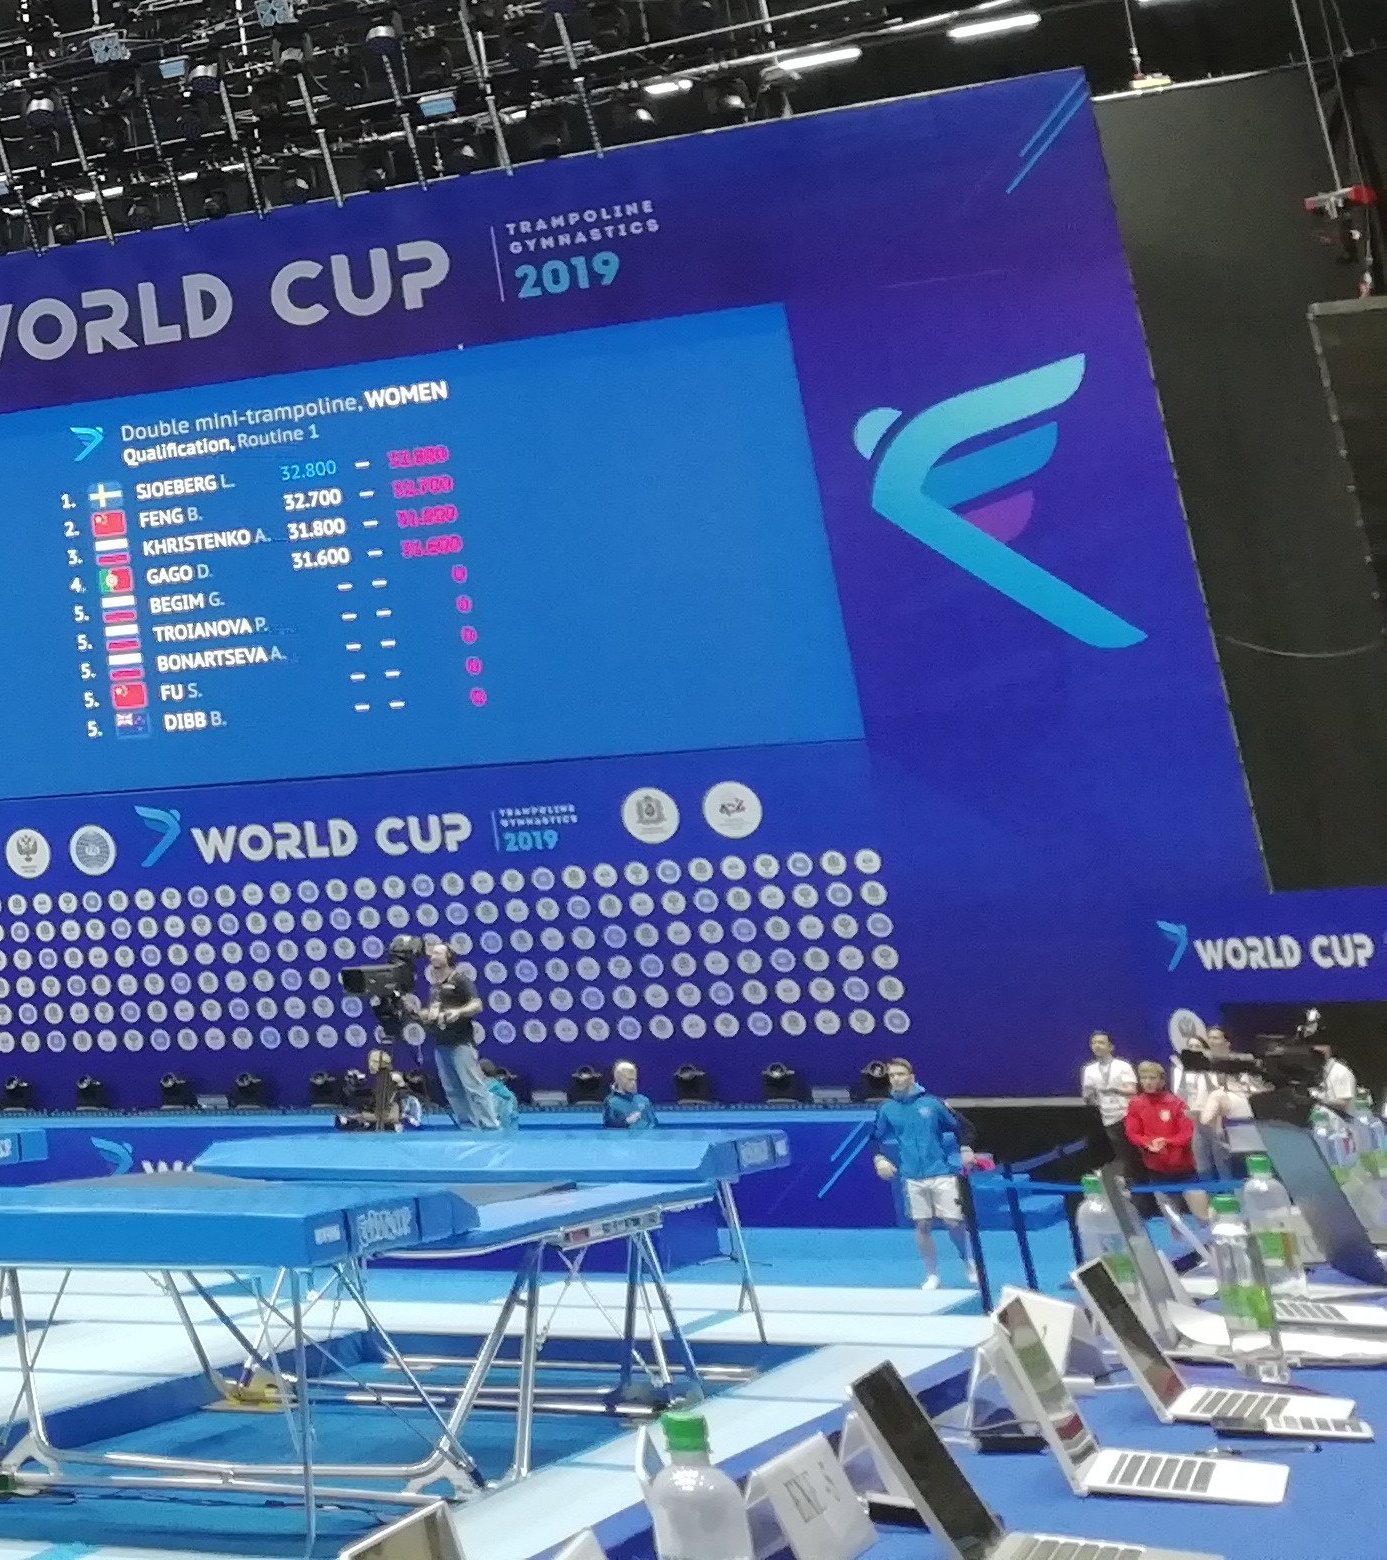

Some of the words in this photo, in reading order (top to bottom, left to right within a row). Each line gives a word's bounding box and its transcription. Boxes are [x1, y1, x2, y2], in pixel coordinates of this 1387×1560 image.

[505, 200, 654, 236] TRAMPOLINE
[509, 218, 660, 254] GYMNASTICS
[269, 240, 451, 326] CUP
[514, 251, 620, 298] 2019
[120, 418, 190, 442] Double
[195, 396, 363, 434] mini-trampoline,
[364, 380, 450, 409] WOMEN
[123, 436, 236, 467] Qualification,
[237, 429, 298, 450] Routine
[309, 424, 320, 440] 1
[61, 493, 77, 510] 1.
[135, 474, 217, 502] SJOEBERG
[280, 460, 336, 482] 32.800
[64, 521, 80, 538] 2.
[139, 507, 184, 530] FENG
[187, 507, 204, 523] B.
[283, 488, 343, 512] 32.700
[67, 549, 83, 565] 3.
[143, 528, 251, 558] KHRISTENKO
[254, 528, 271, 543] A.
[286, 517, 346, 542] 31.800
[70, 577, 86, 593] 4.
[146, 566, 194, 586] GAGO
[197, 563, 214, 580] D.
[291, 547, 351, 571] 31.600
[74, 606, 90, 622] 5.
[149, 593, 205, 614] BEGIM
[208, 591, 225, 607] G.
[77, 634, 93, 651] 5.
[152, 618, 253, 643] TROIANOVA
[255, 617, 269, 633] P.
[80, 663, 96, 679] 5.
[157, 646, 269, 673] BONARTSEVA
[271, 645, 287, 662] A.
[84, 691, 100, 708] 5.
[160, 684, 185, 701] FU
[187, 683, 204, 700] S.
[87, 720, 103, 737] 5.
[164, 712, 208, 732] DIBB
[210, 711, 227, 728] B.
[189, 817, 358, 865] WORLD
[374, 812, 473, 857] CUP
[503, 829, 559, 852] 2019
[1192, 935, 1302, 971] WORLD
[1309, 932, 1376, 969] CUP
